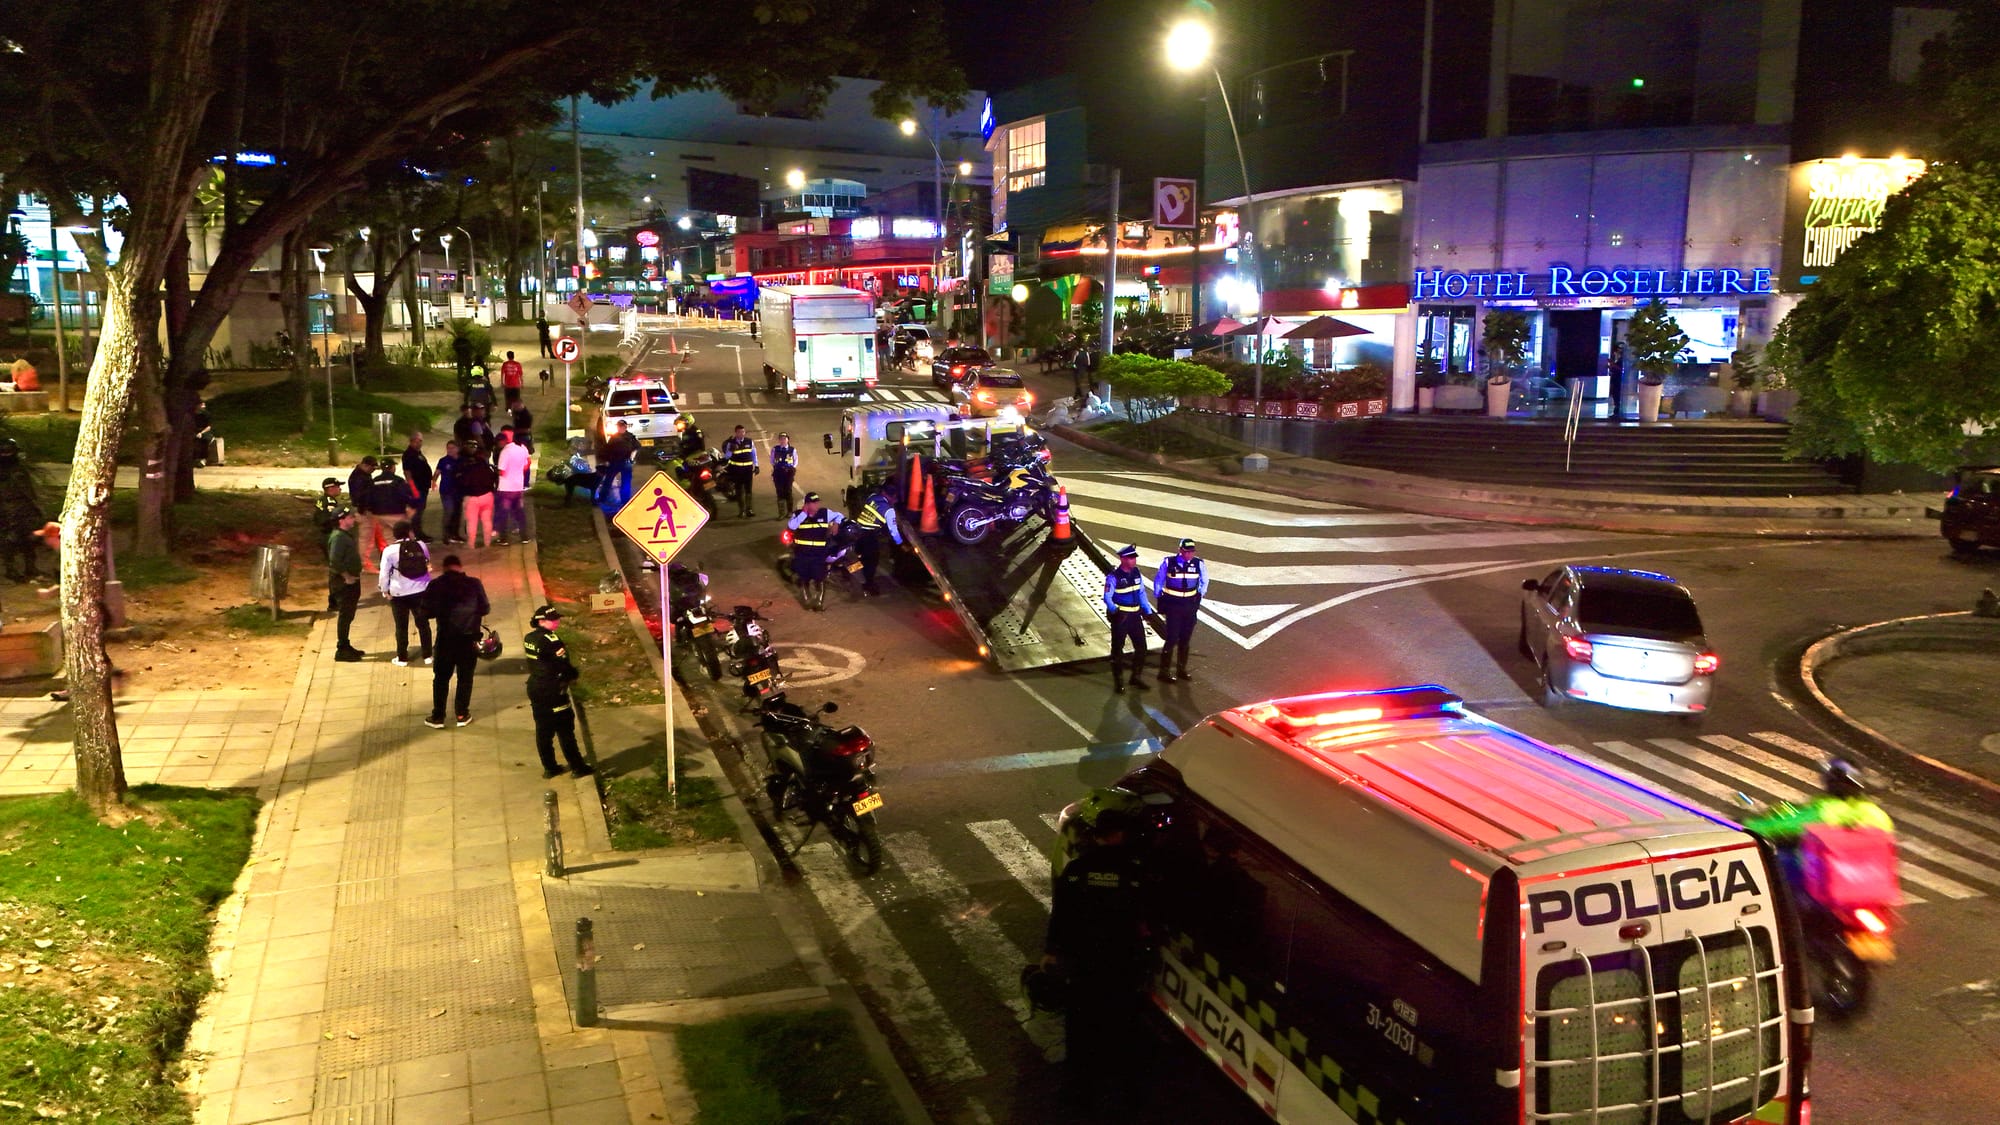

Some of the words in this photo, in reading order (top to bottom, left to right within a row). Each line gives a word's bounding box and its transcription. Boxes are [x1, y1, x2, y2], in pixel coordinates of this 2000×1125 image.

[1413, 269, 1535, 300] HOTEL
[1547, 265, 1774, 297] ROSELIERE
[1366, 1002, 1416, 1056] 31-2031
